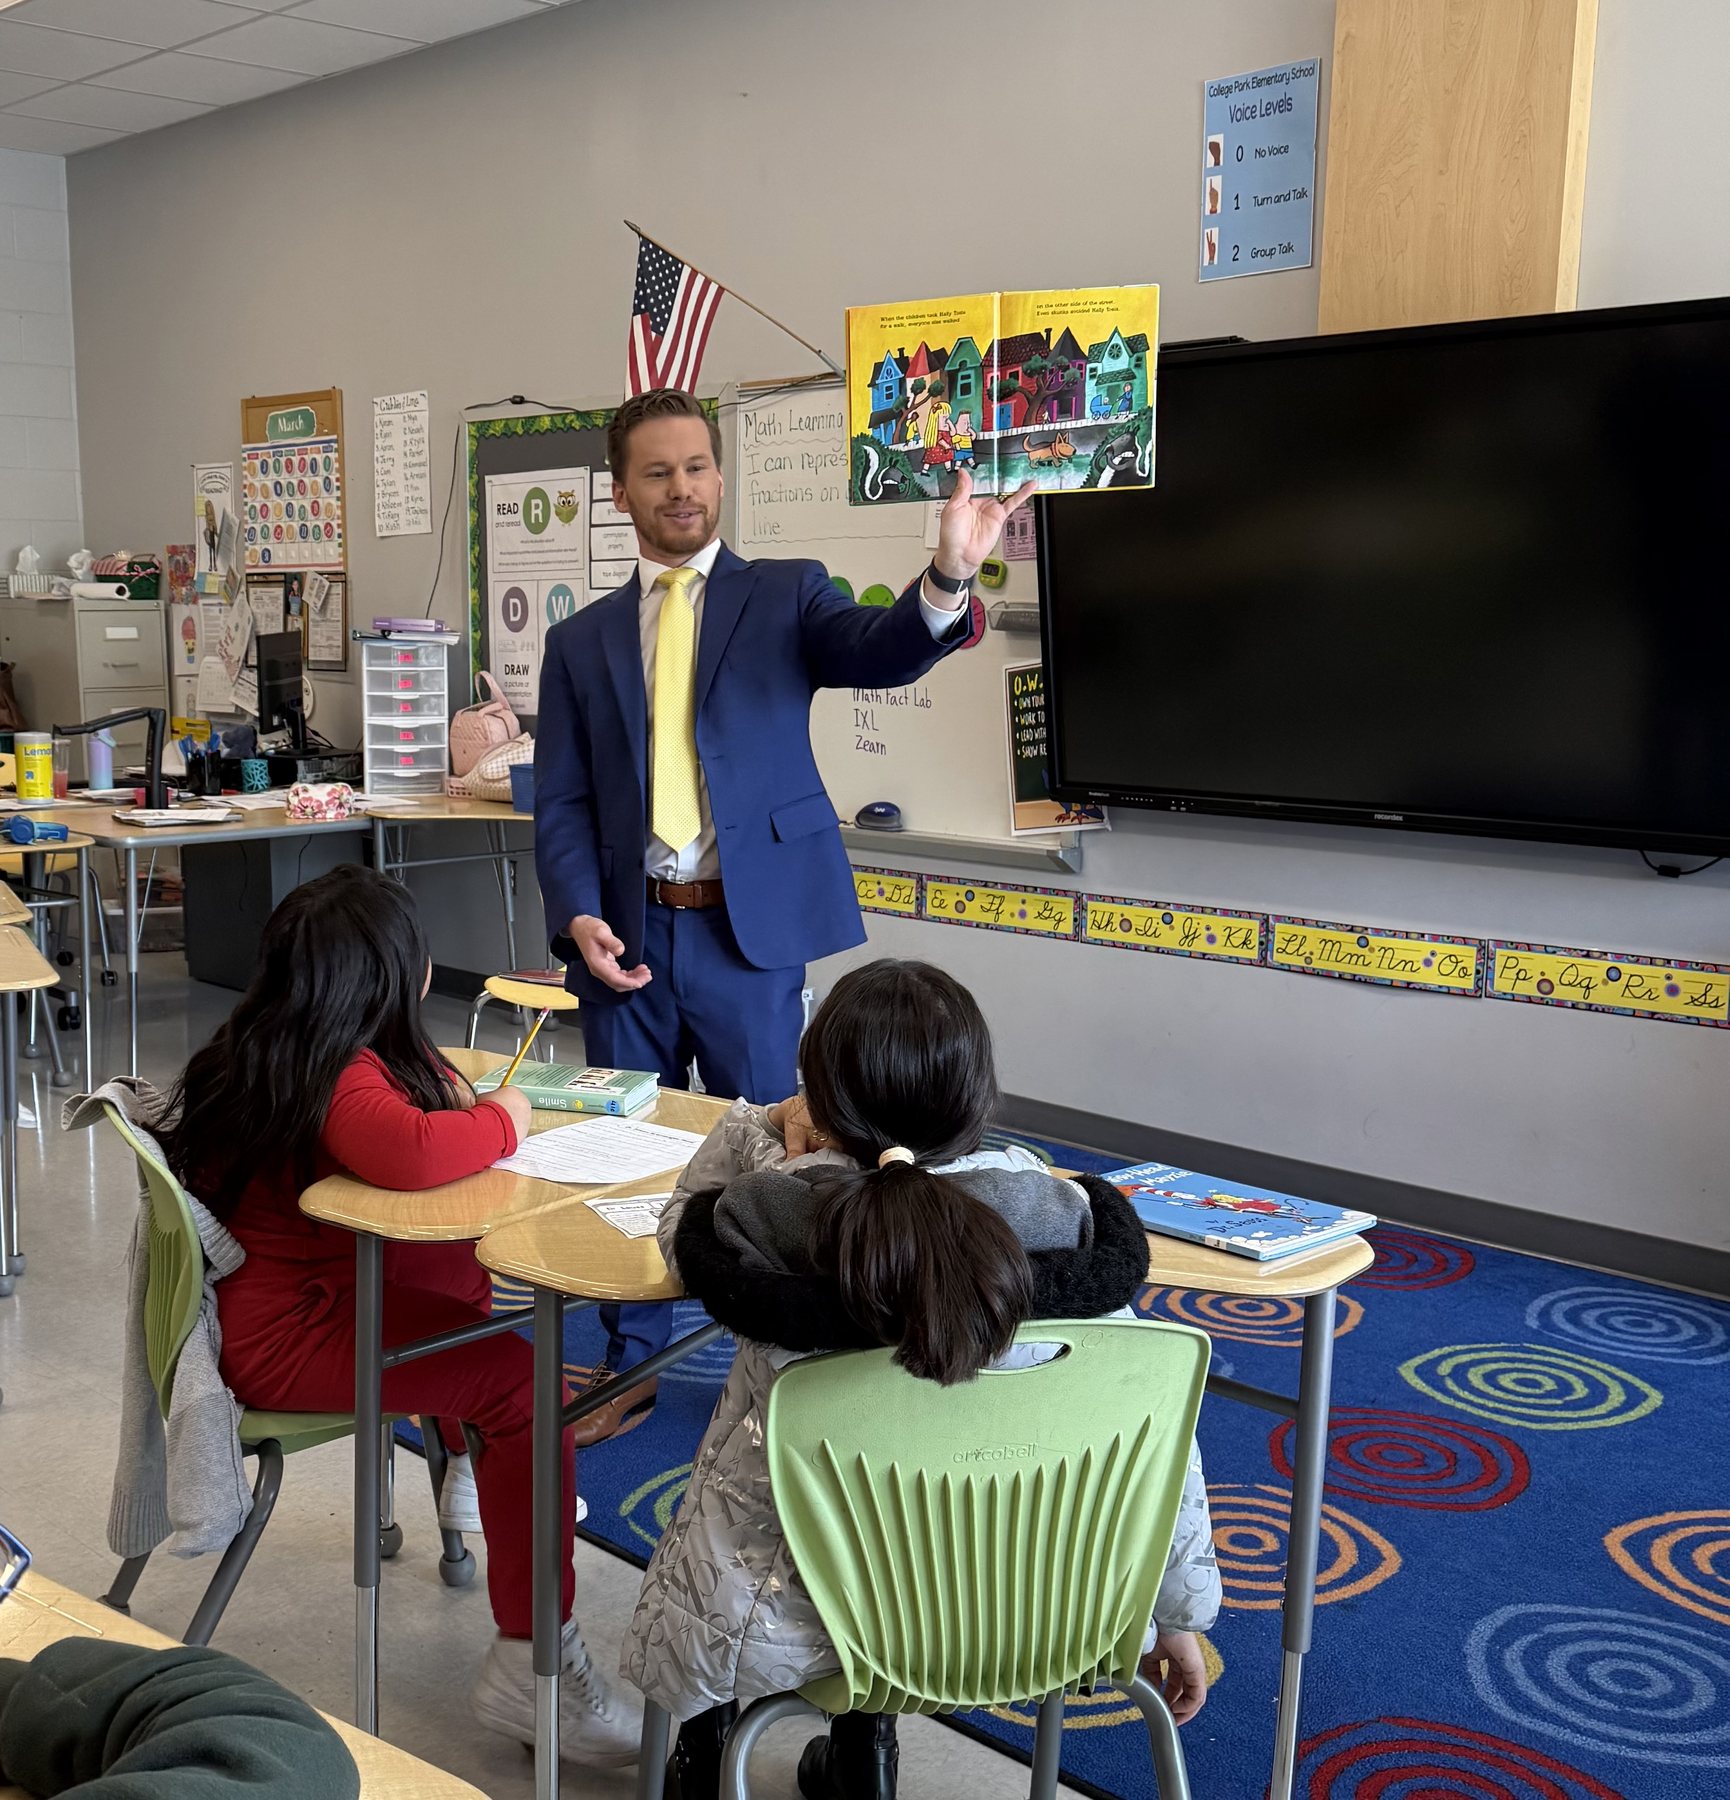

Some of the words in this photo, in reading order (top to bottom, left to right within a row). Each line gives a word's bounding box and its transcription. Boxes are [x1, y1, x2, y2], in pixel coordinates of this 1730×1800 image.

[1209, 85, 1233, 98] College
[1234, 78, 1251, 93] Park
[1251, 71, 1290, 90] Elementary
[1291, 63, 1315, 80] School
[1229, 102, 1257, 124] Voice
[1259, 91, 1293, 118] Levels
[1236, 145, 1244, 162] 0
[1254, 148, 1266, 159] No
[1267, 144, 1289, 157] Voice
[1233, 193, 1240, 210] 1
[1253, 196, 1273, 207] Turn
[1273, 190, 1291, 204] and
[1291, 187, 1308, 201] Talk
[1232, 244, 1240, 262] 2
[1250, 247, 1276, 260] Group
[1277, 241, 1295, 255] Talk
[277, 414, 305, 433] March
[744, 412, 782, 442] Math
[789, 409, 844, 452] Learning
[747, 453, 760, 476] I
[764, 454, 793, 473] can
[749, 480, 813, 506] fractions
[820, 488, 840, 502] on
[496, 503, 519, 516] READ
[530, 498, 544, 524] R
[752, 508, 781, 537] line
[509, 598, 522, 622] D
[551, 595, 571, 620] W
[504, 664, 530, 676] DRAW
[914, 687, 932, 708] Lab
[1018, 696, 1031, 709] OWN
[853, 709, 879, 731] IXL
[1020, 711, 1036, 725] WORK
[1037, 711, 1045, 723] TO
[855, 735, 886, 755] Zearn
[1021, 728, 1034, 742] LEAD
[1021, 745, 1038, 758] SHOW
[856, 879, 876, 900] Cc
[886, 882, 914, 906] Dd
[931, 890, 948, 909] Ee
[1089, 908, 1116, 934] Hh
[1223, 926, 1256, 952] Kk
[1276, 933, 1308, 957] Ll
[1318, 937, 1371, 967] Mm
[1377, 945, 1421, 973] Nn
[1437, 953, 1473, 978] Oo
[1499, 956, 1533, 991] Pp
[1621, 973, 1660, 1001] Rr
[1684, 983, 1727, 1009] Ss
[538, 1096, 567, 1109] Smile
[1138, 1170, 1195, 1186] Mayzie
